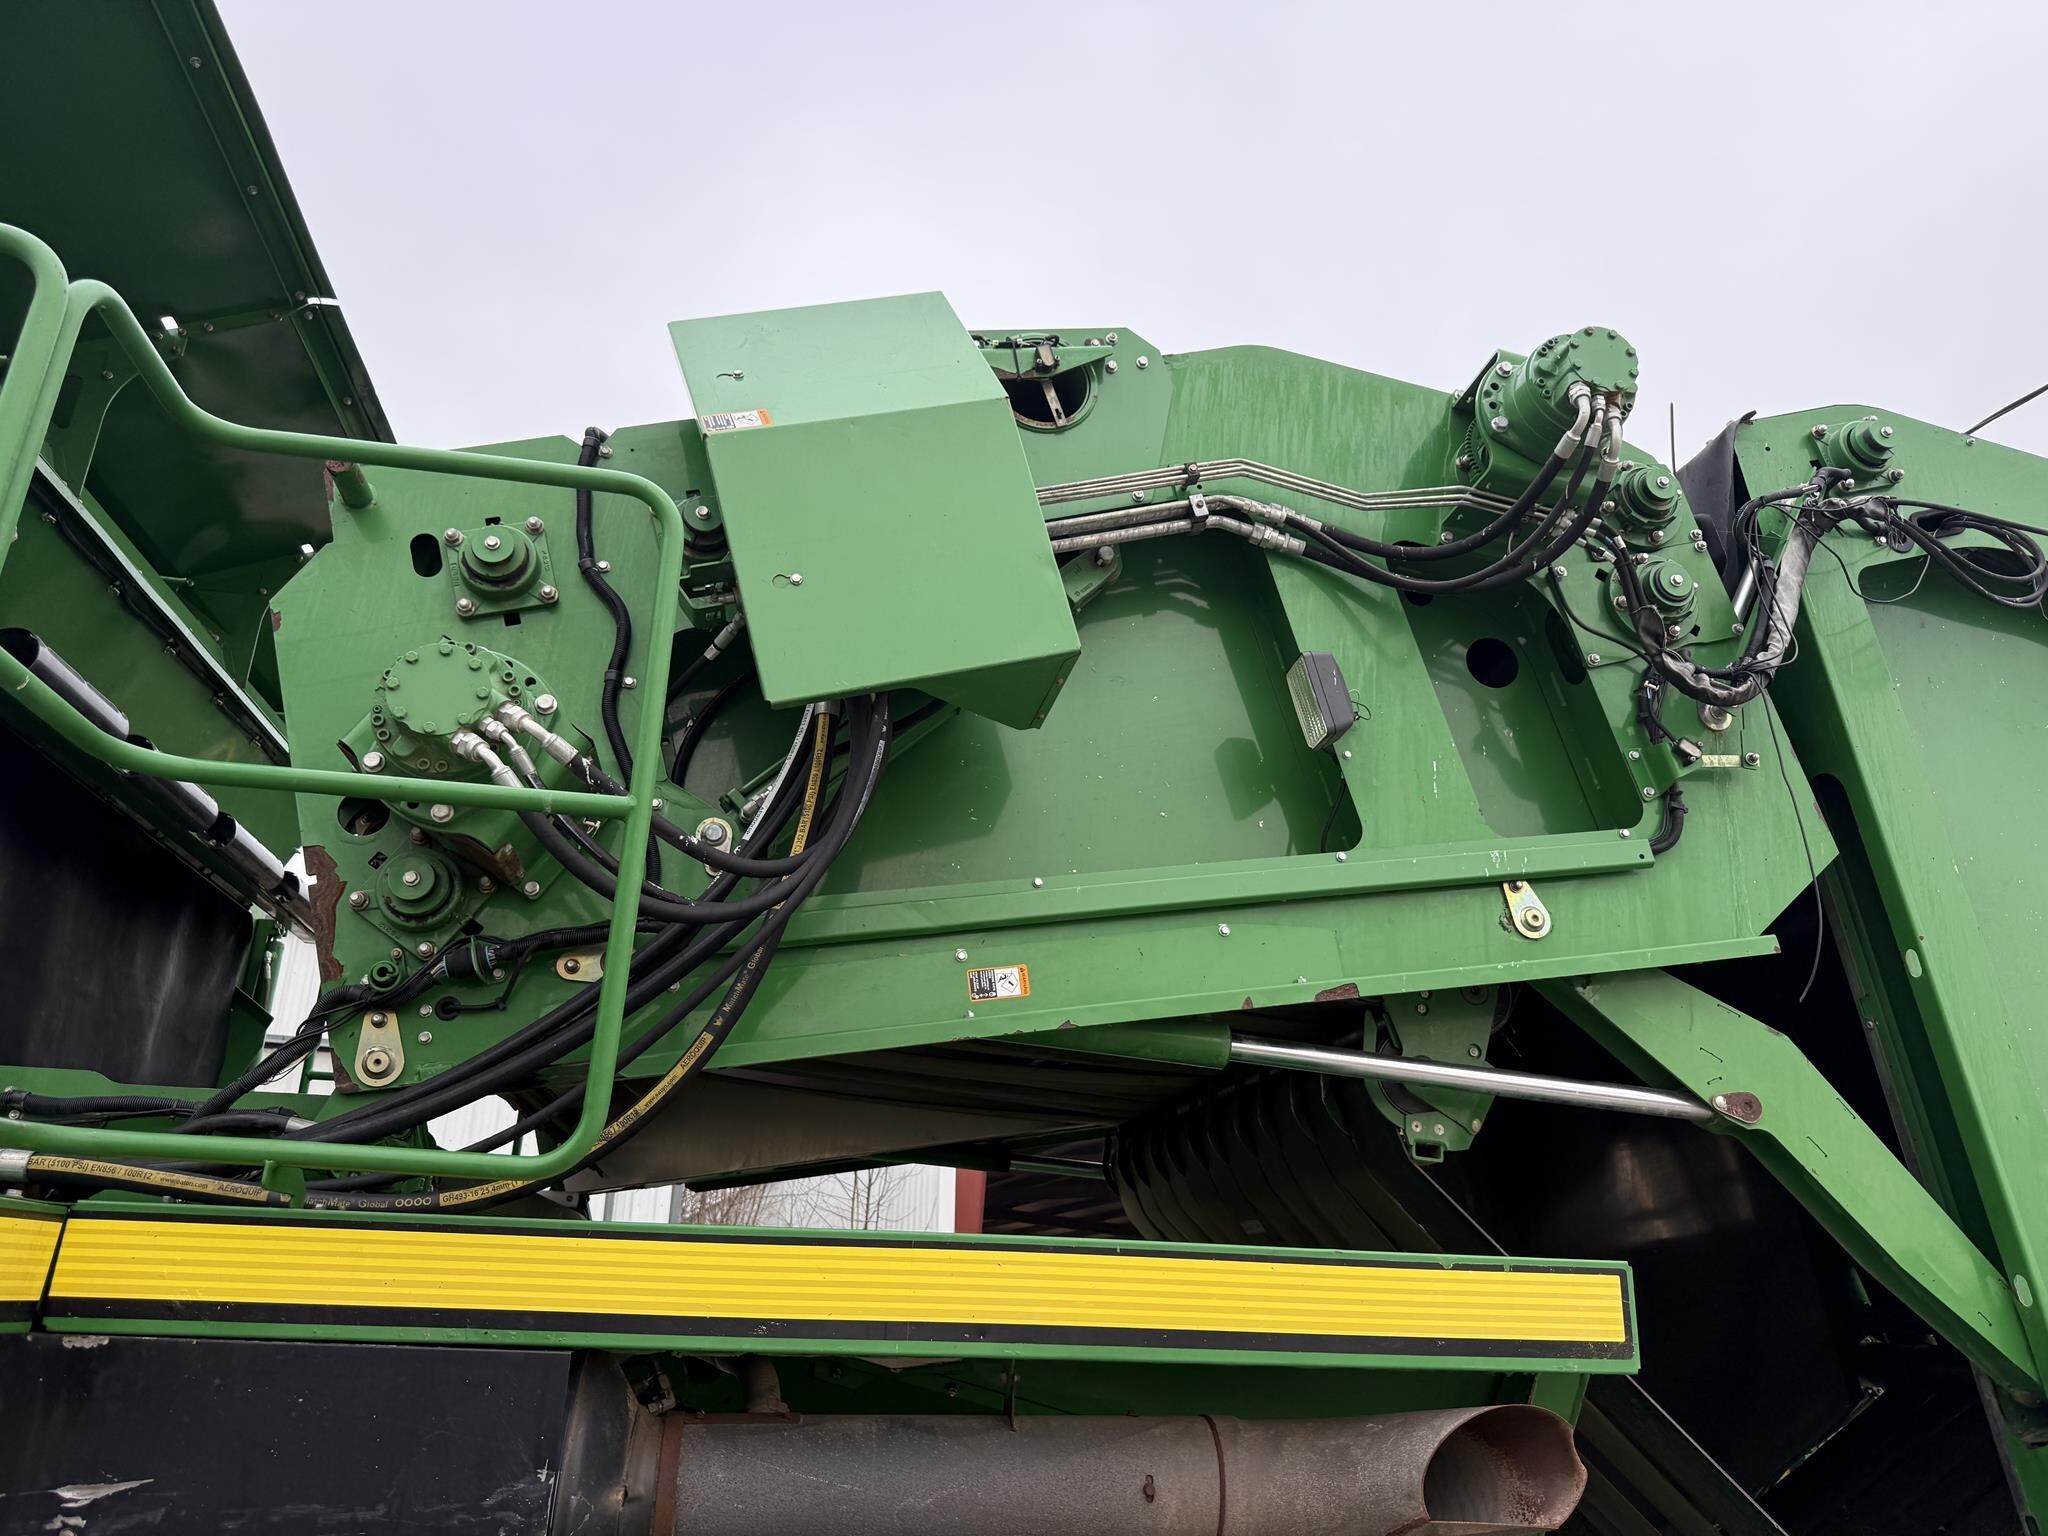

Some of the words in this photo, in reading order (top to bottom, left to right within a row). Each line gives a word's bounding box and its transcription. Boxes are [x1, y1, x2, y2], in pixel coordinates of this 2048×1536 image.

[800, 819, 809, 833] BAR
[47, 1157, 71, 1169] (5100
[71, 1159, 90, 1171] PSI)
[90, 1161, 116, 1174] EN856
[122, 1167, 153, 1180] 100R12
[217, 1183, 263, 1197] AEROQUIP
[358, 1199, 388, 1209] Global
